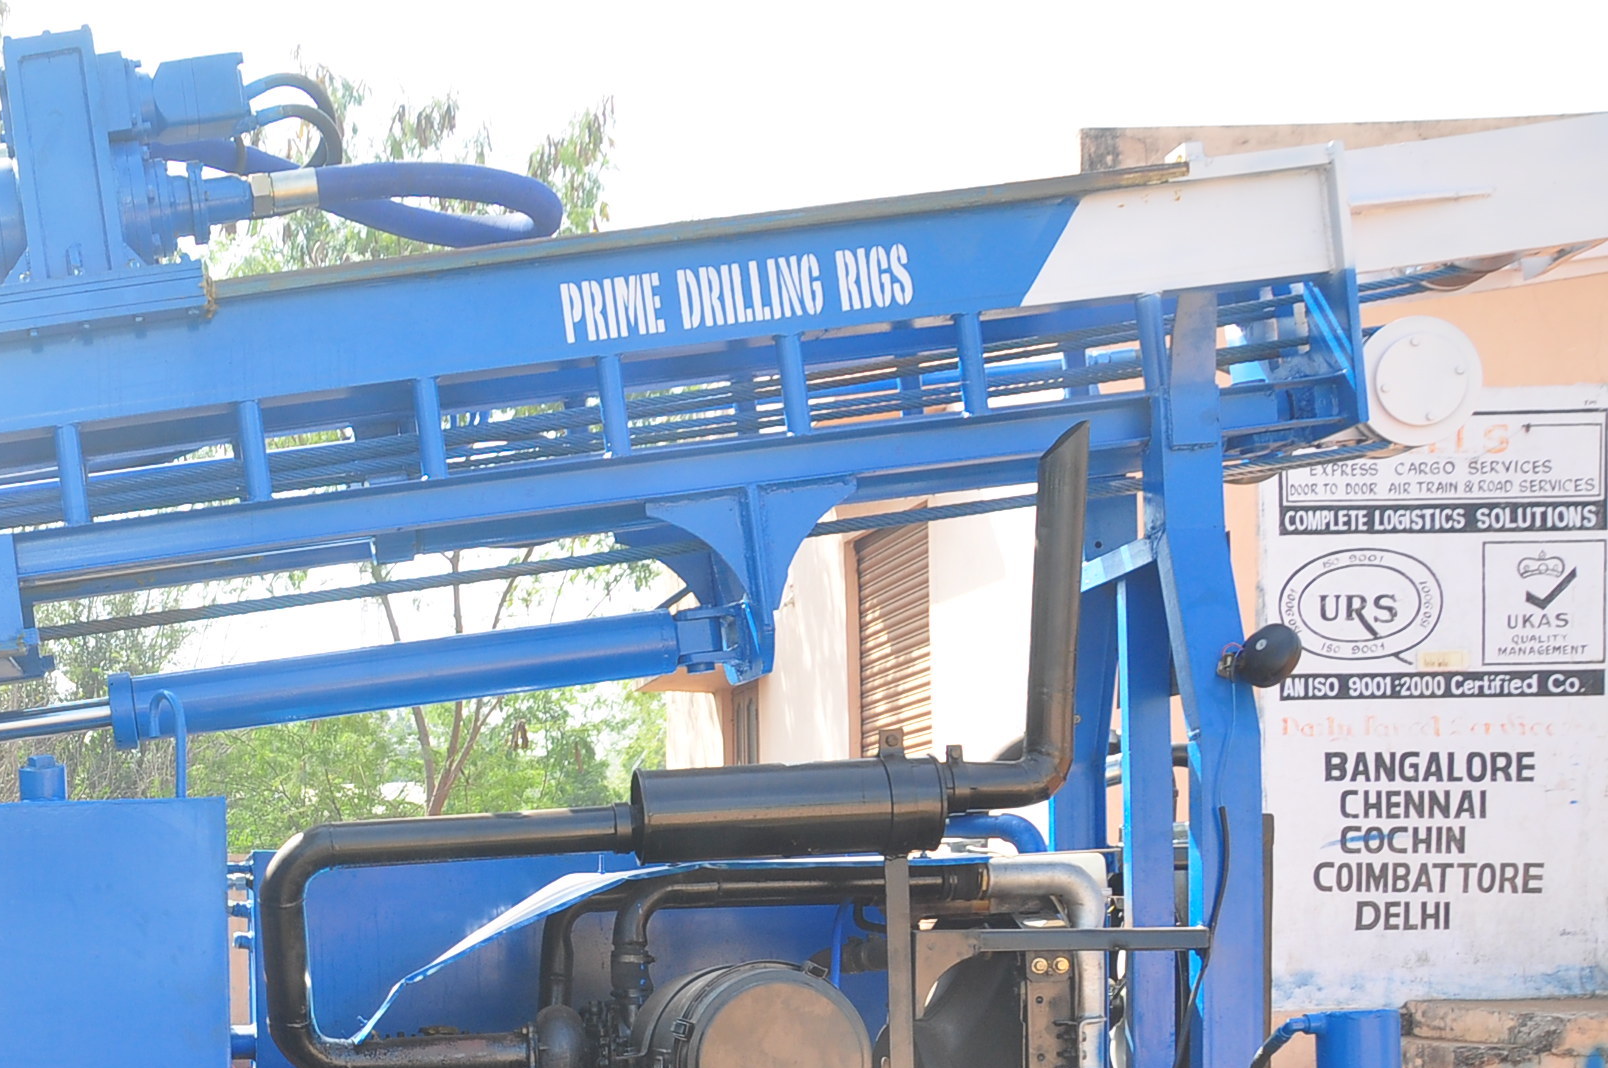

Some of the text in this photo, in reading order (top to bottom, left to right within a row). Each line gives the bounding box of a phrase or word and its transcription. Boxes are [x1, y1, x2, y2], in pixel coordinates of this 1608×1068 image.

[560, 243, 914, 344] PRIME DRILLING RIGS
[1309, 459, 1553, 477] EXPRESS CARGO SERVICES
[1289, 477, 1596, 496] DOOR TO DOOR AIR TRAIN & ROAD SERVICES
[1284, 505, 1598, 532] COMPLETE LOGISTICS SOLUTIONS
[1318, 593, 1398, 637] URS
[1507, 612, 1569, 630] UKAS
[1497, 643, 1589, 657] MANAGEMENT
[1511, 633, 1568, 646] QUALITY
[1282, 676, 1305, 698] AN
[1308, 676, 1340, 697] ISO
[1450, 673, 1539, 696] Certified
[1547, 673, 1586, 694] Co.
[1323, 751, 1536, 783] BANGALORE
[1339, 789, 1488, 820] CHENNAI
[1339, 825, 1467, 855] COCHIN
[1312, 861, 1545, 894] COIMBATTORE
[1354, 900, 1451, 931] DELHI
